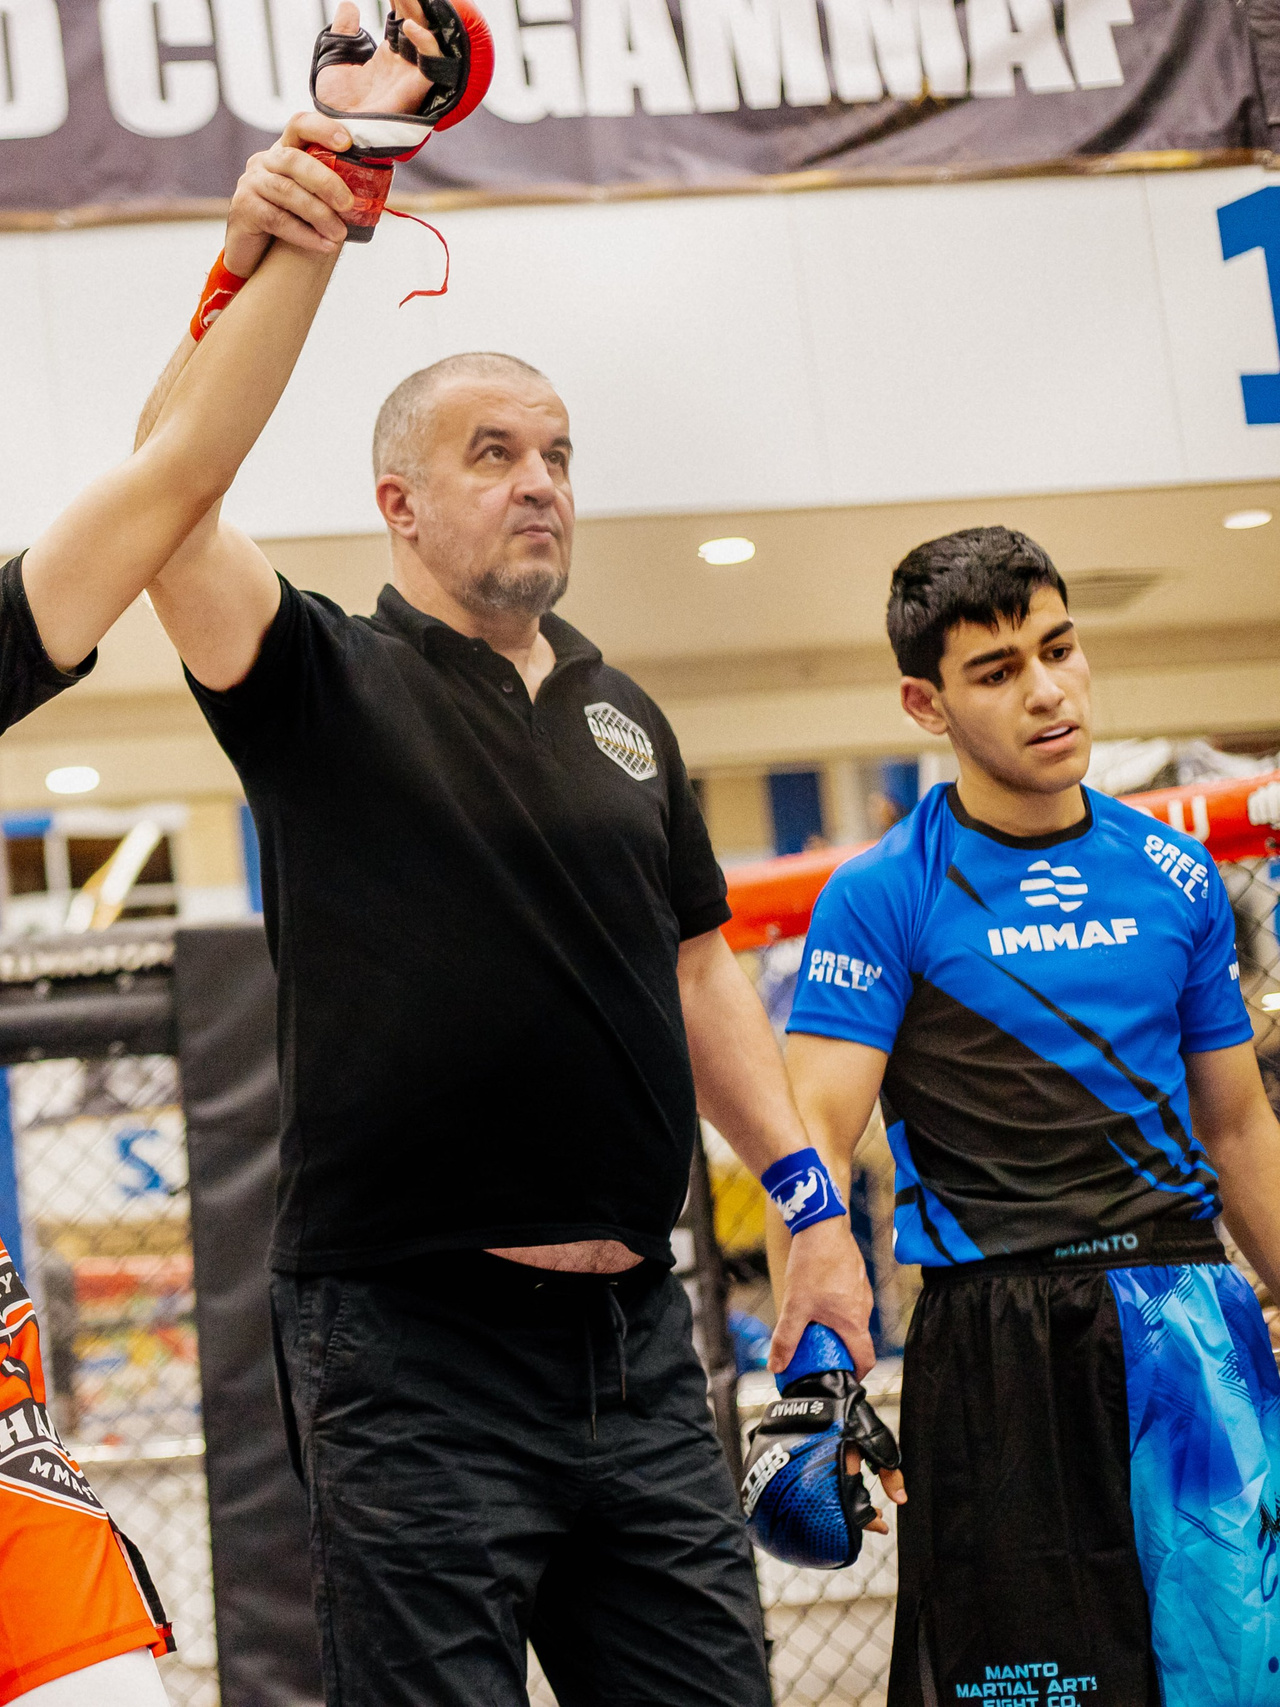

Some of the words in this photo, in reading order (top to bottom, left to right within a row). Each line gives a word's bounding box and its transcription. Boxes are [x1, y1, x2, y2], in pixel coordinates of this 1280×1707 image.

[987, 917, 1139, 957] IMMAF
[808, 963, 868, 992] HILL
[811, 948, 883, 980] GREEN
[985, 1662, 1059, 1681] MANTO
[955, 1681, 1039, 1698] MARTIAL
